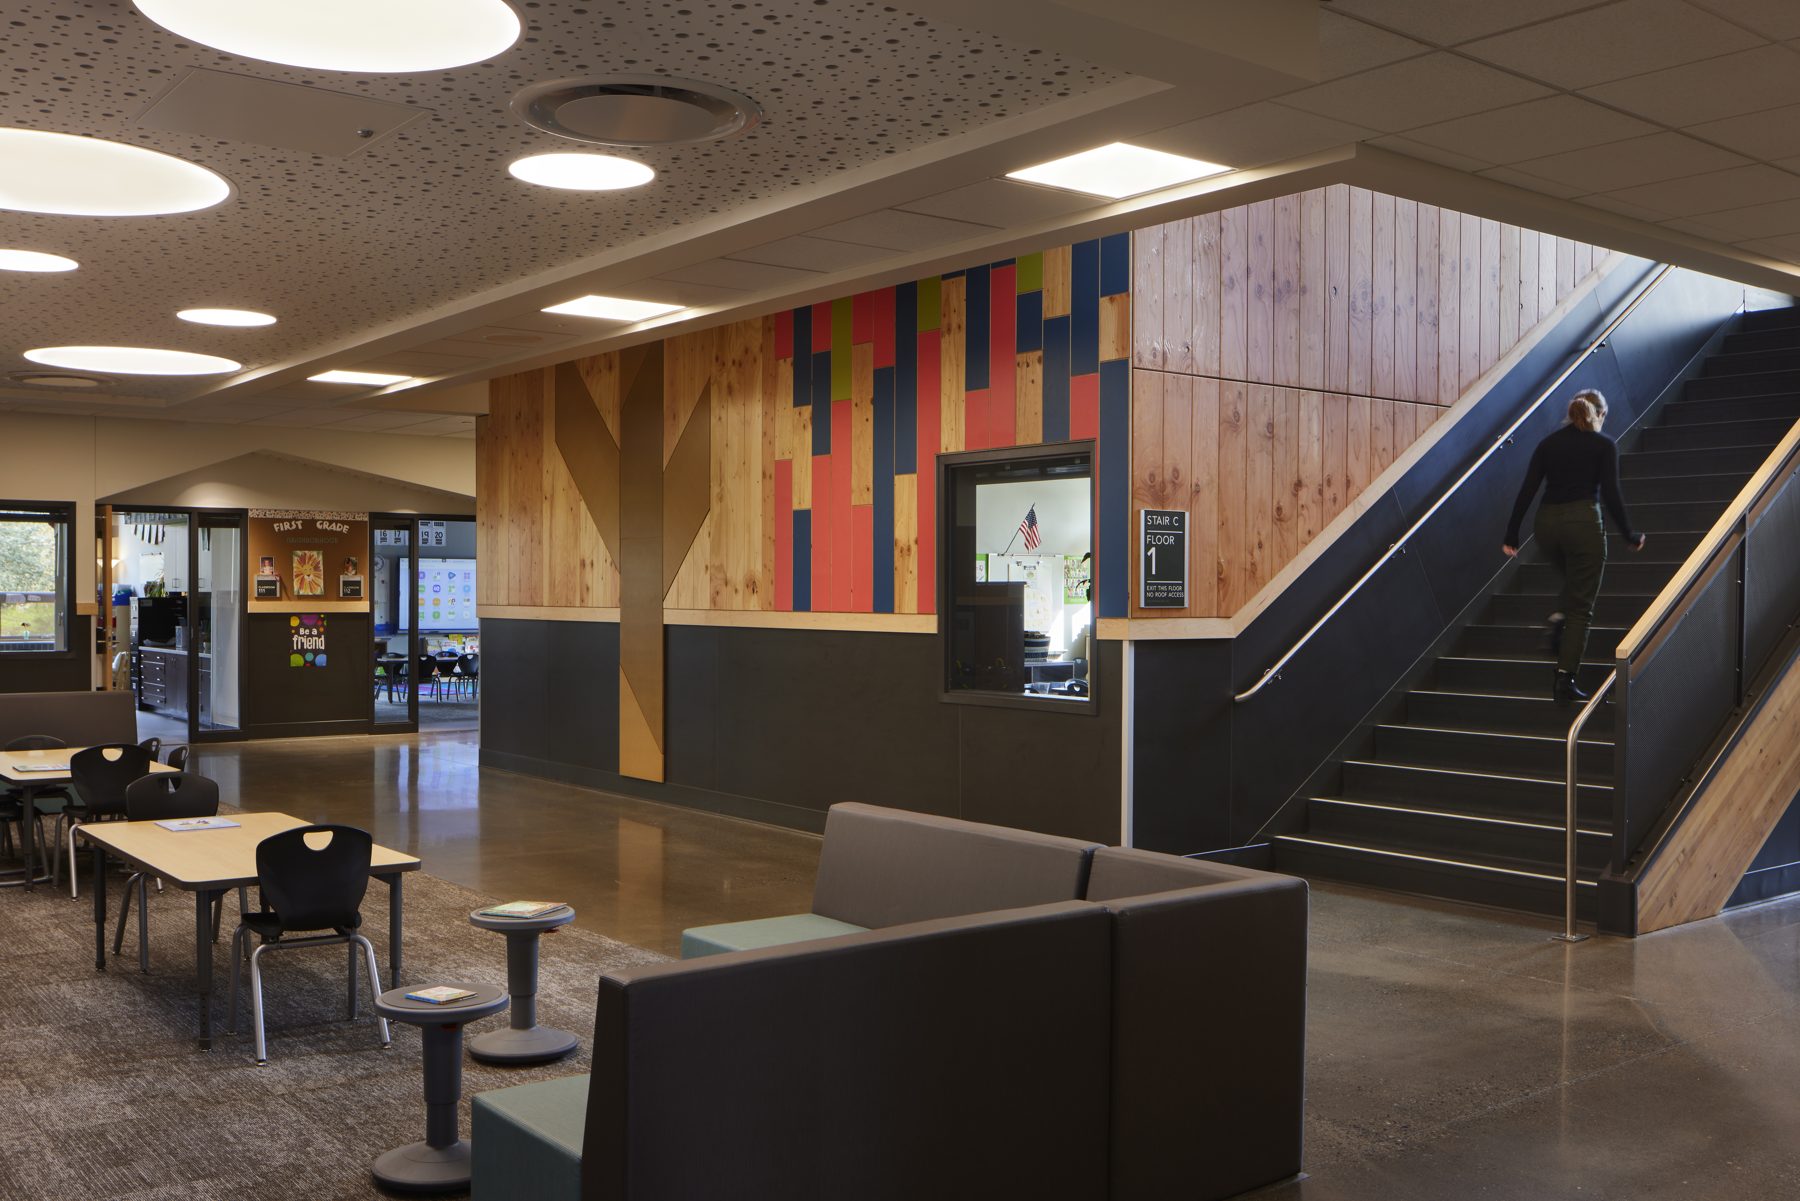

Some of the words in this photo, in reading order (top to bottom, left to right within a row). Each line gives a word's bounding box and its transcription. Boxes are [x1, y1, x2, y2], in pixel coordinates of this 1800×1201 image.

[1146, 515, 1170, 526] STAIR
[1172, 516, 1179, 526] C
[273, 520, 303, 533] FIRST
[316, 520, 350, 534] GRADE
[434, 531, 444, 539] 20
[1146, 535, 1175, 545] FLOOR
[1147, 546, 1156, 575] 1
[299, 627, 310, 635] Be
[292, 634, 325, 650] friend
